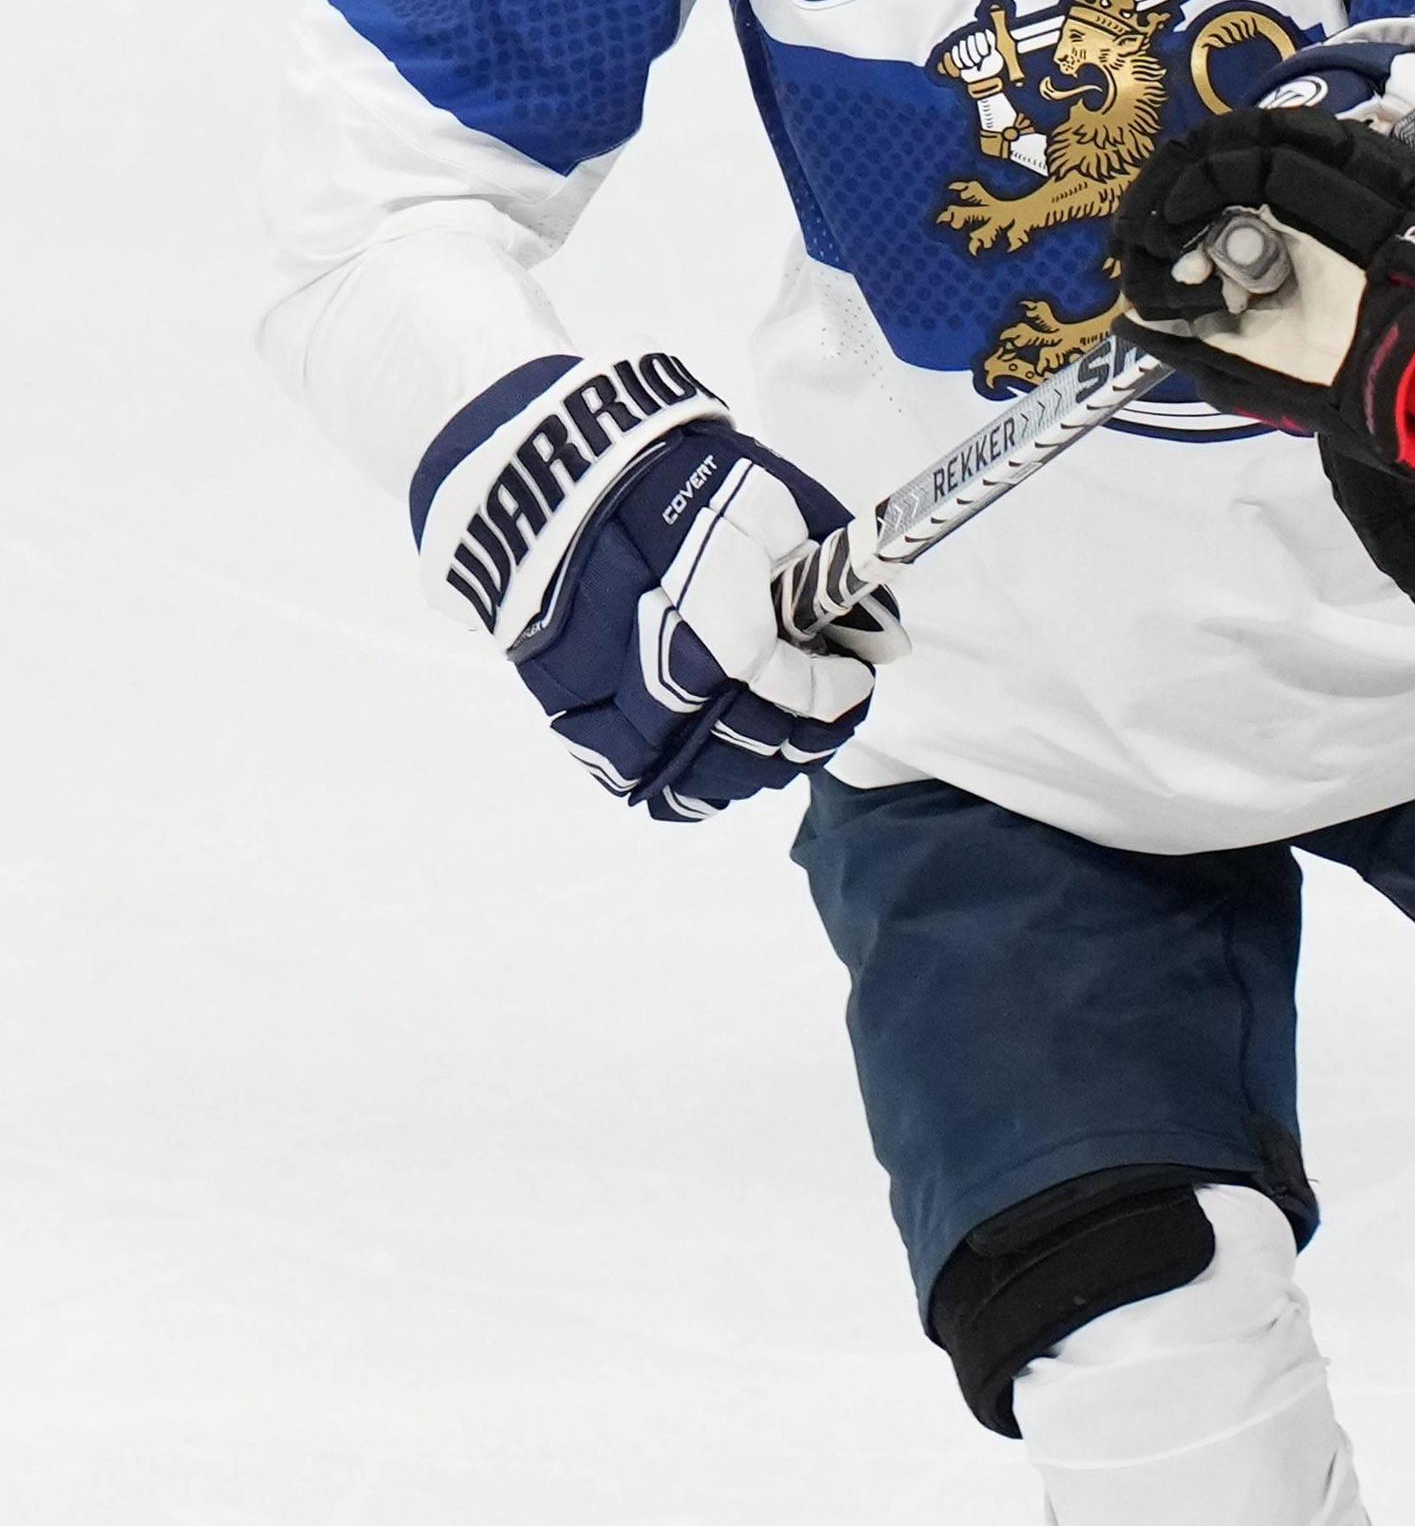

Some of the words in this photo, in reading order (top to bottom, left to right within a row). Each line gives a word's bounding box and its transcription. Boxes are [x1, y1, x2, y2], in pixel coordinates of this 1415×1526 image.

[446, 351, 730, 635] WARRIO
[661, 454, 718, 526] COVERT
[931, 416, 1017, 504] REKKER
